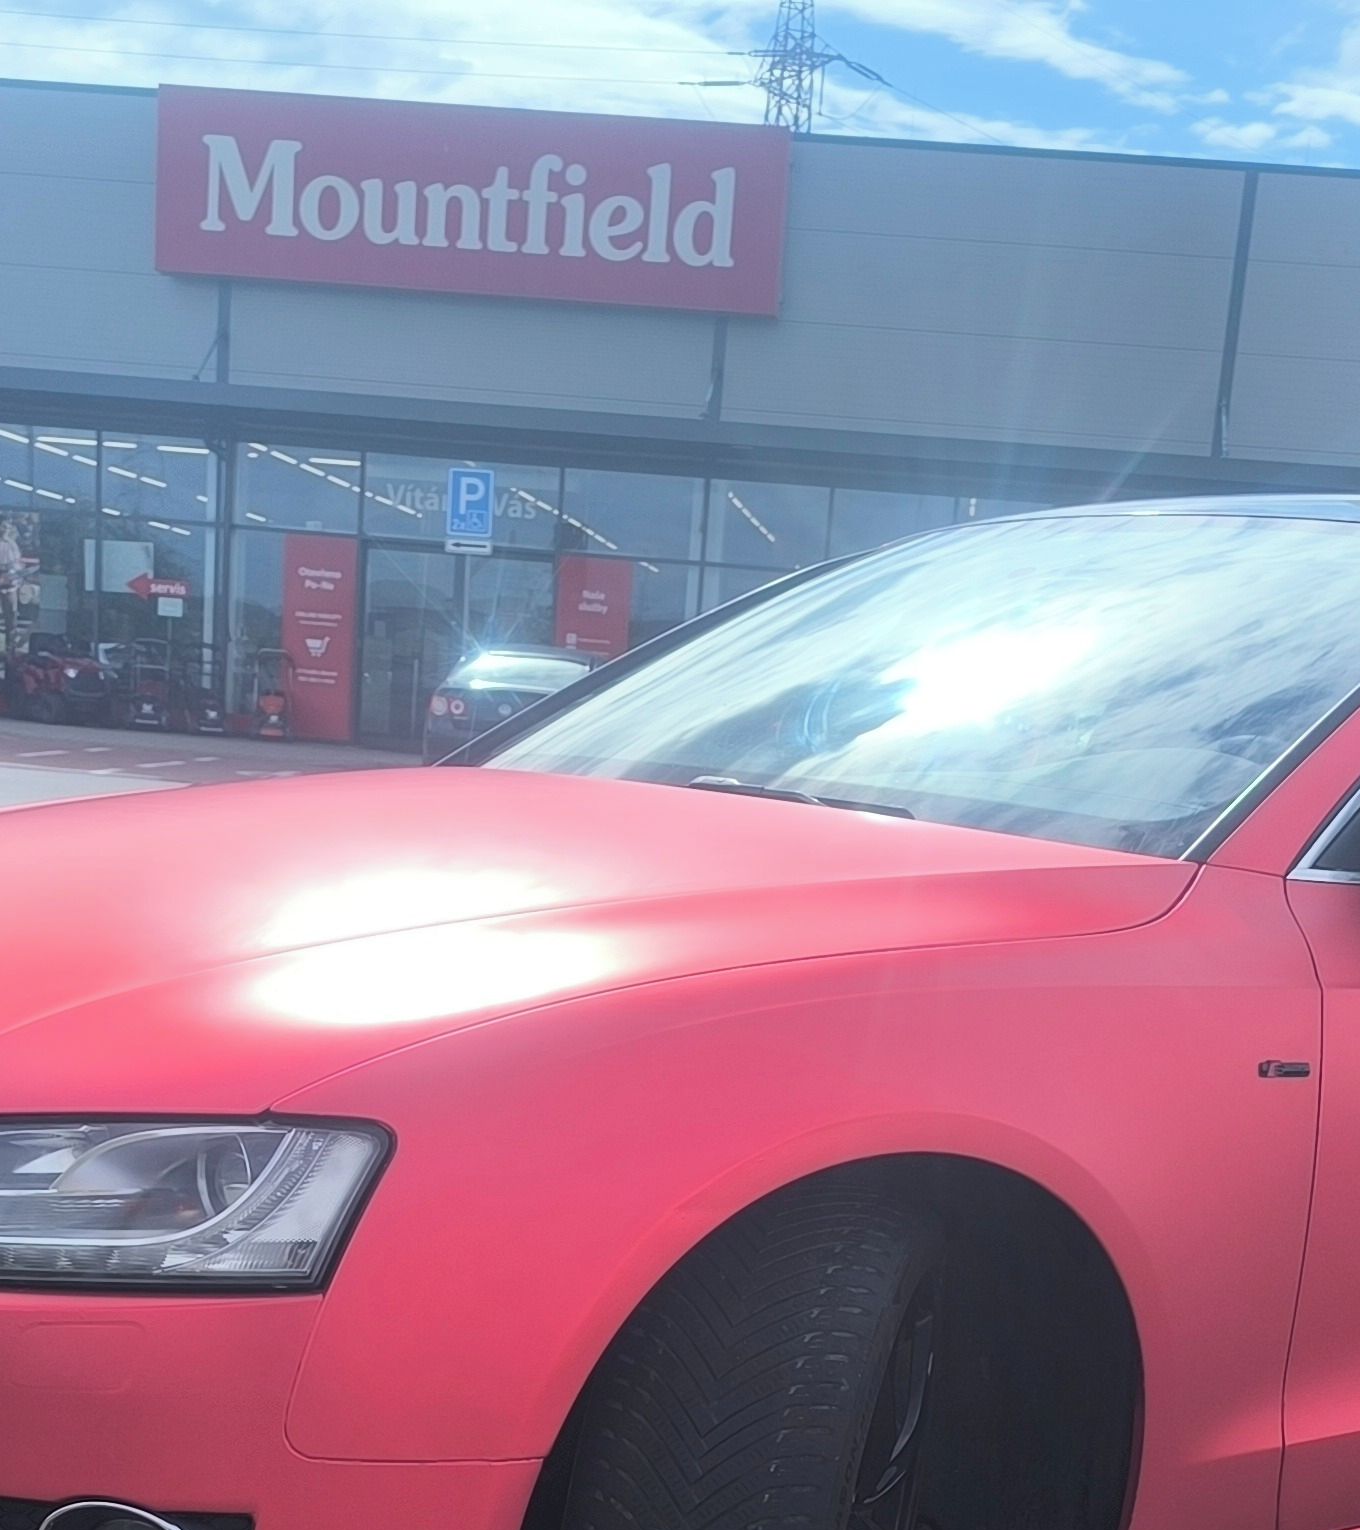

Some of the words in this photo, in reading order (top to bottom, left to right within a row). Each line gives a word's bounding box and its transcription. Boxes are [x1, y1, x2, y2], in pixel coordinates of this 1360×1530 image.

[199, 133, 736, 269] Mountfield
[459, 476, 486, 515] P
[150, 583, 186, 595] servis
